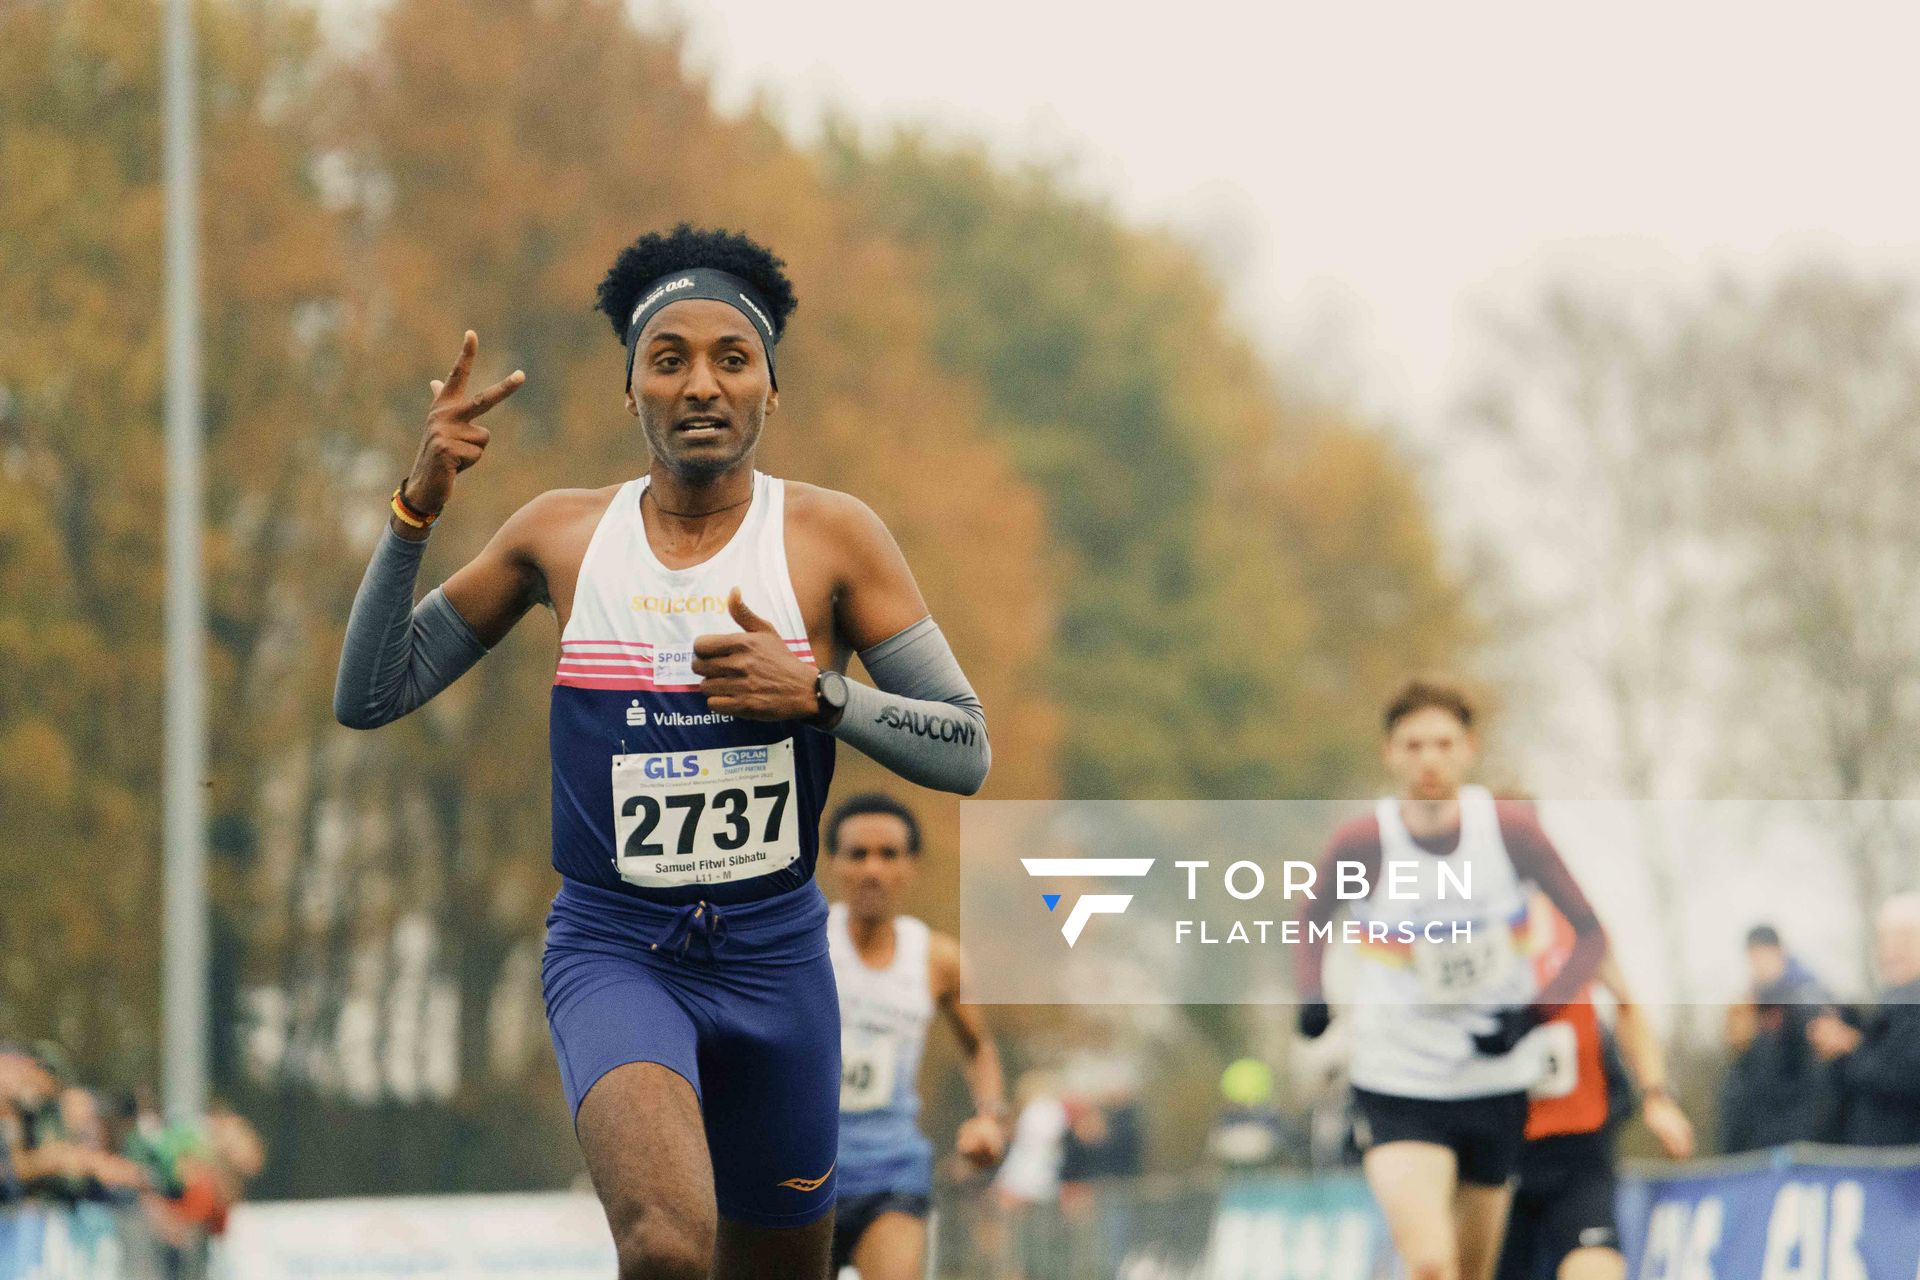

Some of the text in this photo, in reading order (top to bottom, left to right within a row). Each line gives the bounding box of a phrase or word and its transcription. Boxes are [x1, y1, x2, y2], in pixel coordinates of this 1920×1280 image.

[881, 706, 977, 747] SAUCONY
[621, 780, 790, 857] 2737
[655, 862, 696, 874] Samuel
[729, 851, 767, 867] Sibhatu
[723, 871, 732, 879] M
